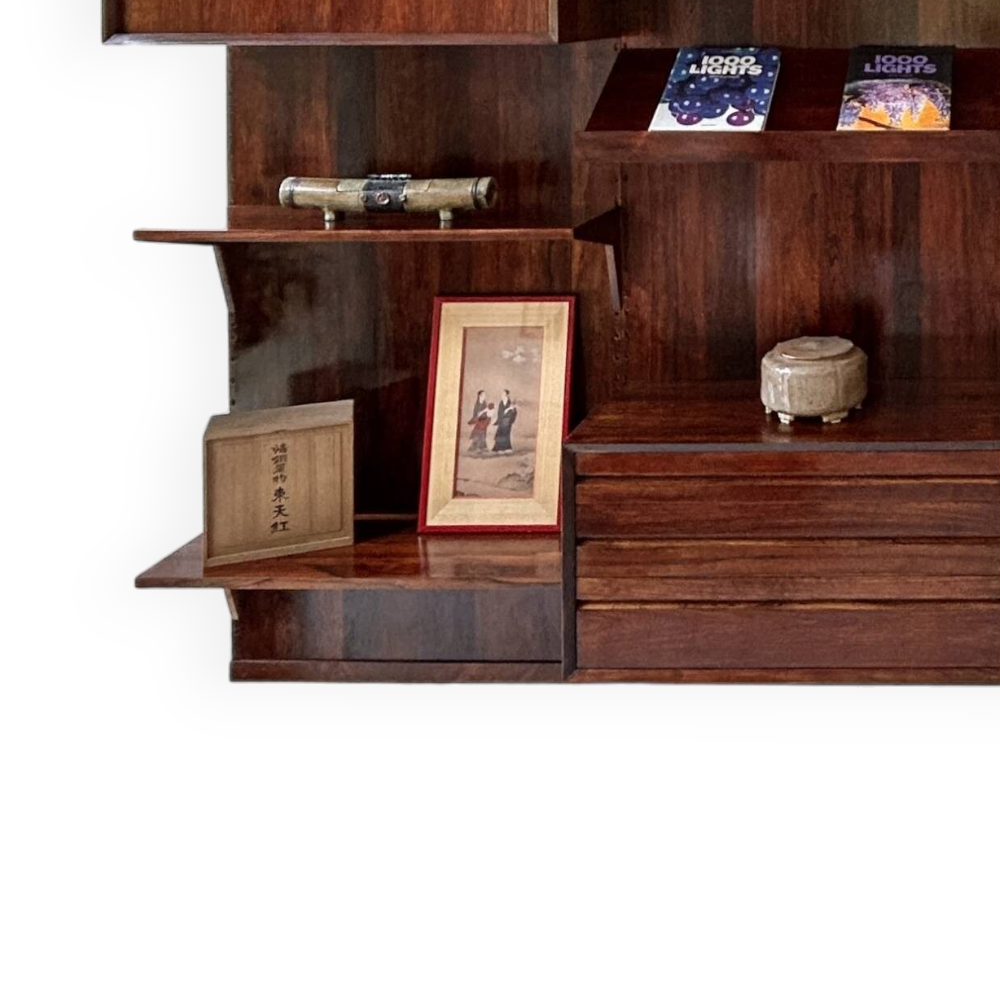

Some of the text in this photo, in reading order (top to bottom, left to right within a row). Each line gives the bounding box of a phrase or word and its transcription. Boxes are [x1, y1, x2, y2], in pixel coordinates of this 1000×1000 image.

[701, 55, 756, 65] 1000
[874, 54, 928, 64] 1000
[689, 63, 763, 75] LIGHTS
[864, 62, 937, 74] LIGHTS
